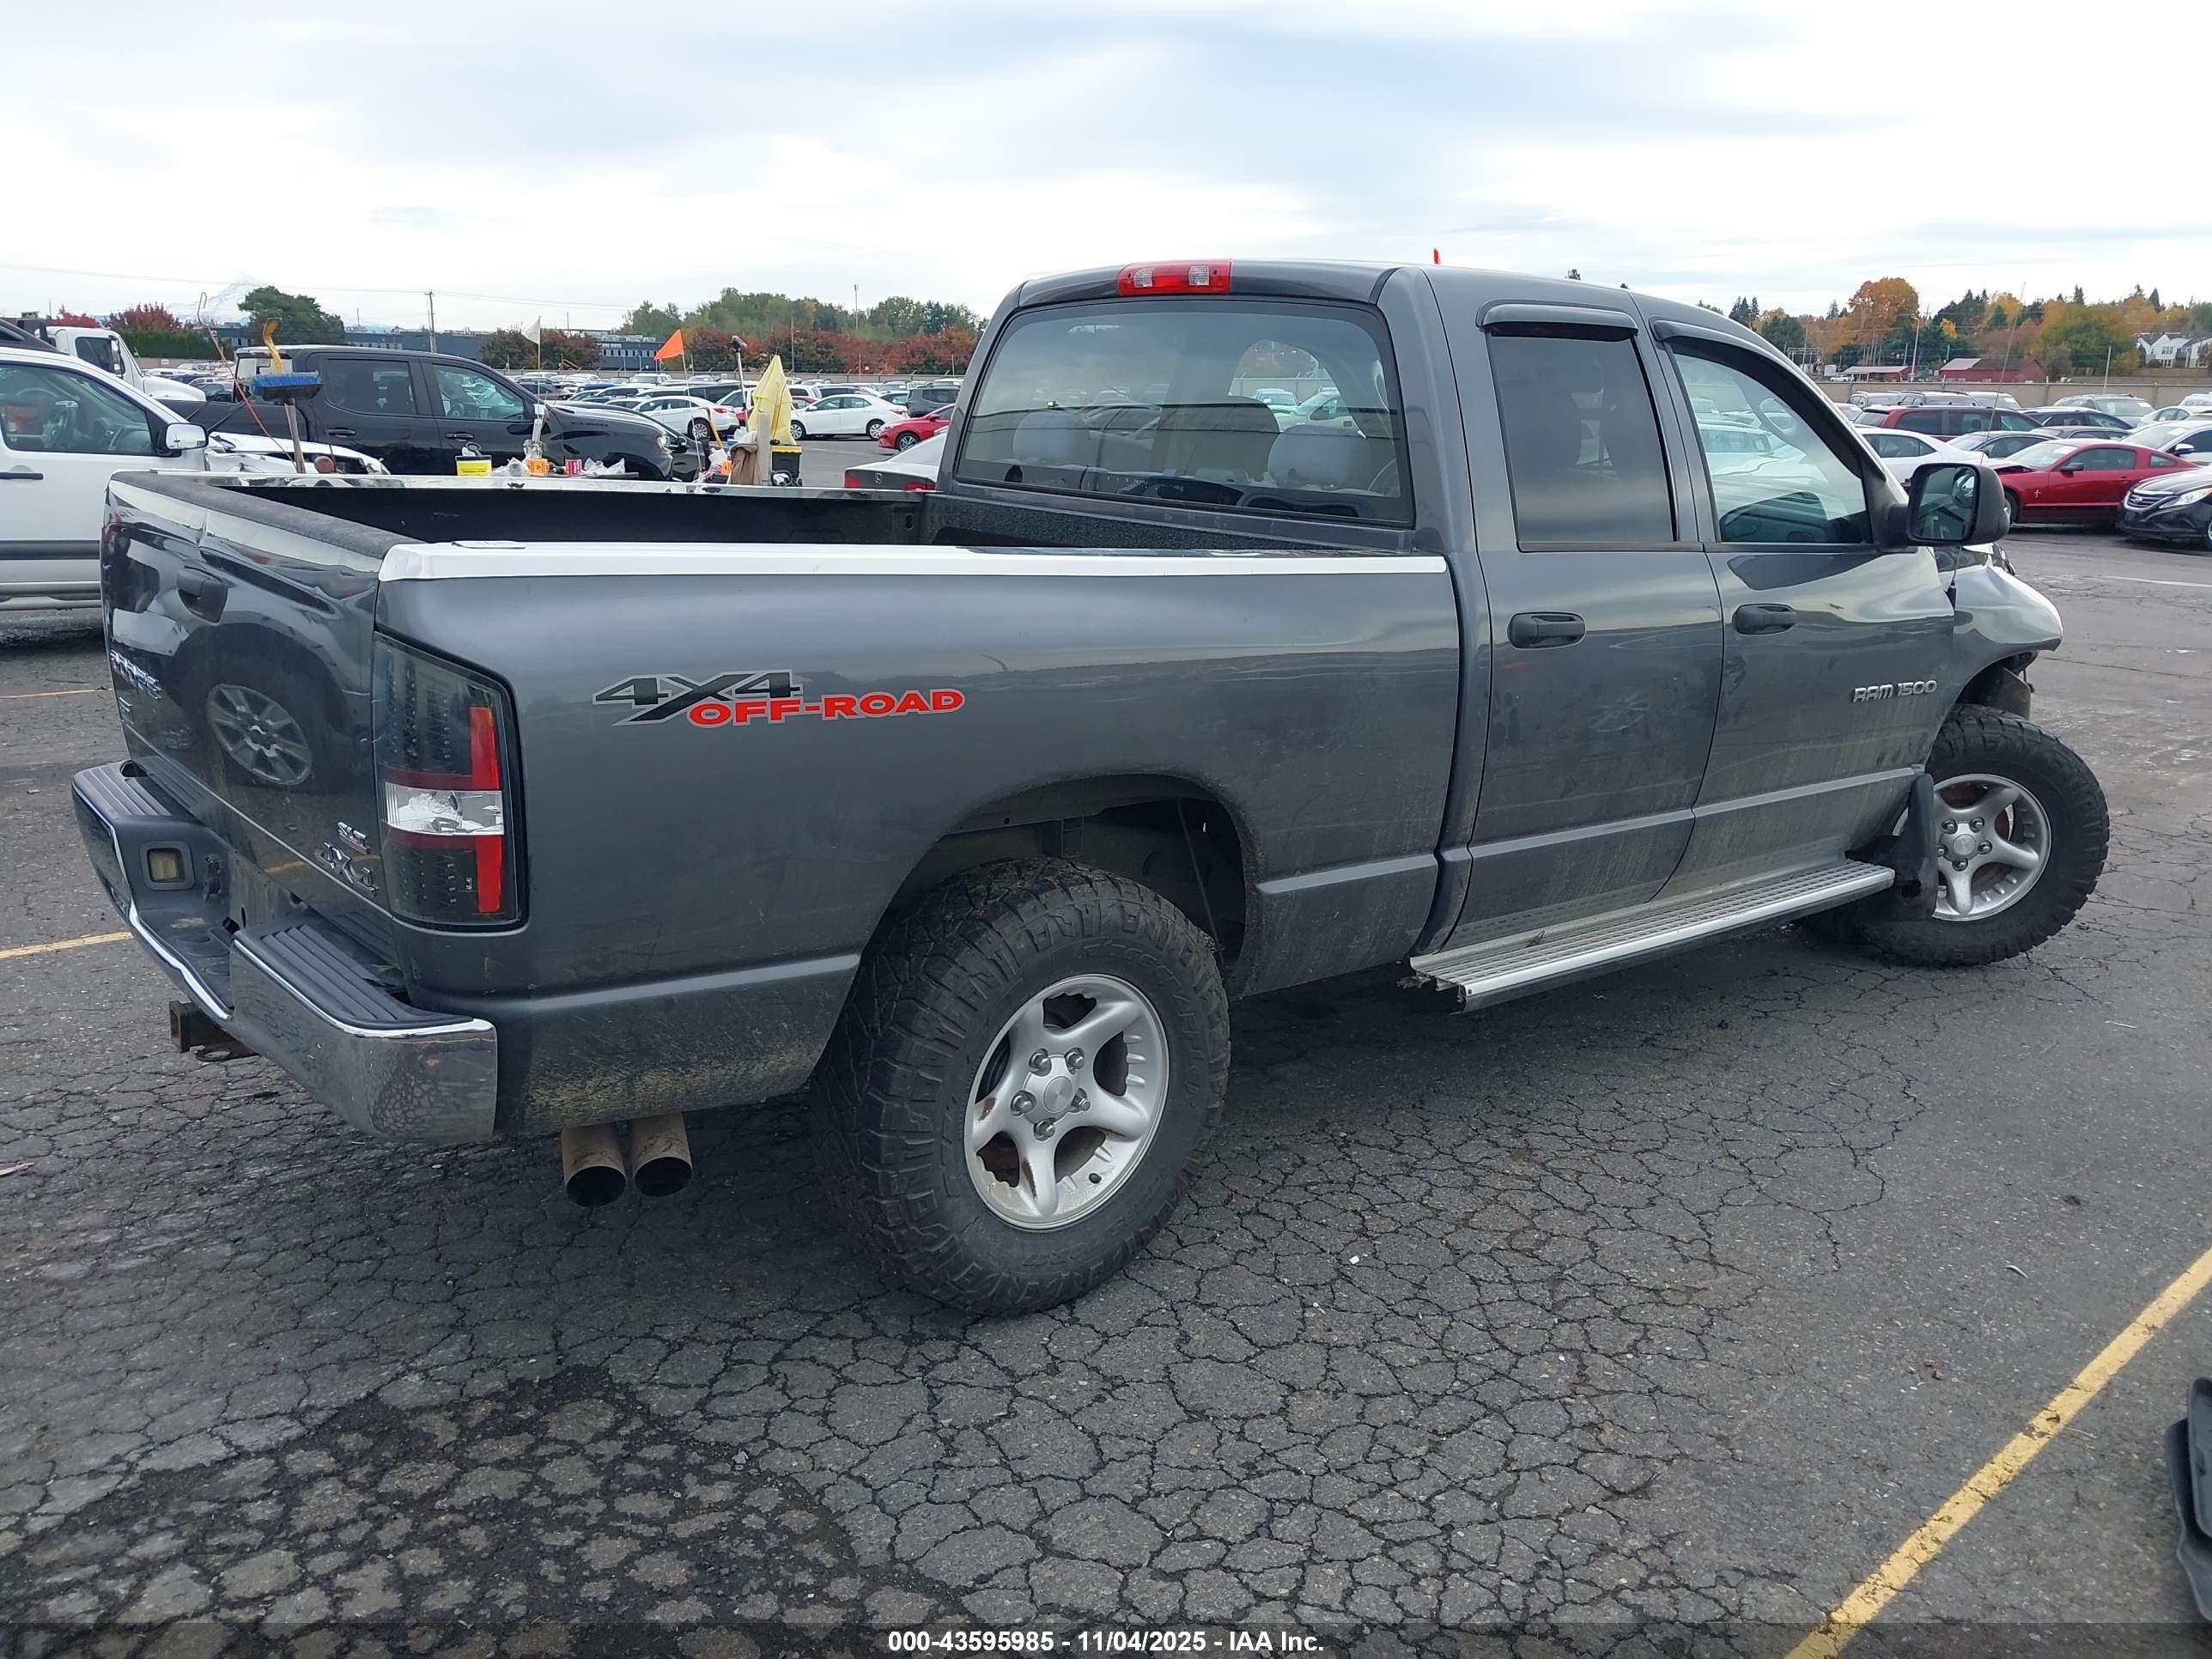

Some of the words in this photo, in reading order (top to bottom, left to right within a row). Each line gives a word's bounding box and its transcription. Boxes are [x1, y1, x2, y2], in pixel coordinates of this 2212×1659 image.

[1853, 684, 1893, 703] RAM
[1897, 680, 1937, 697] 1500
[689, 689, 965, 727] OFF-ROAD
